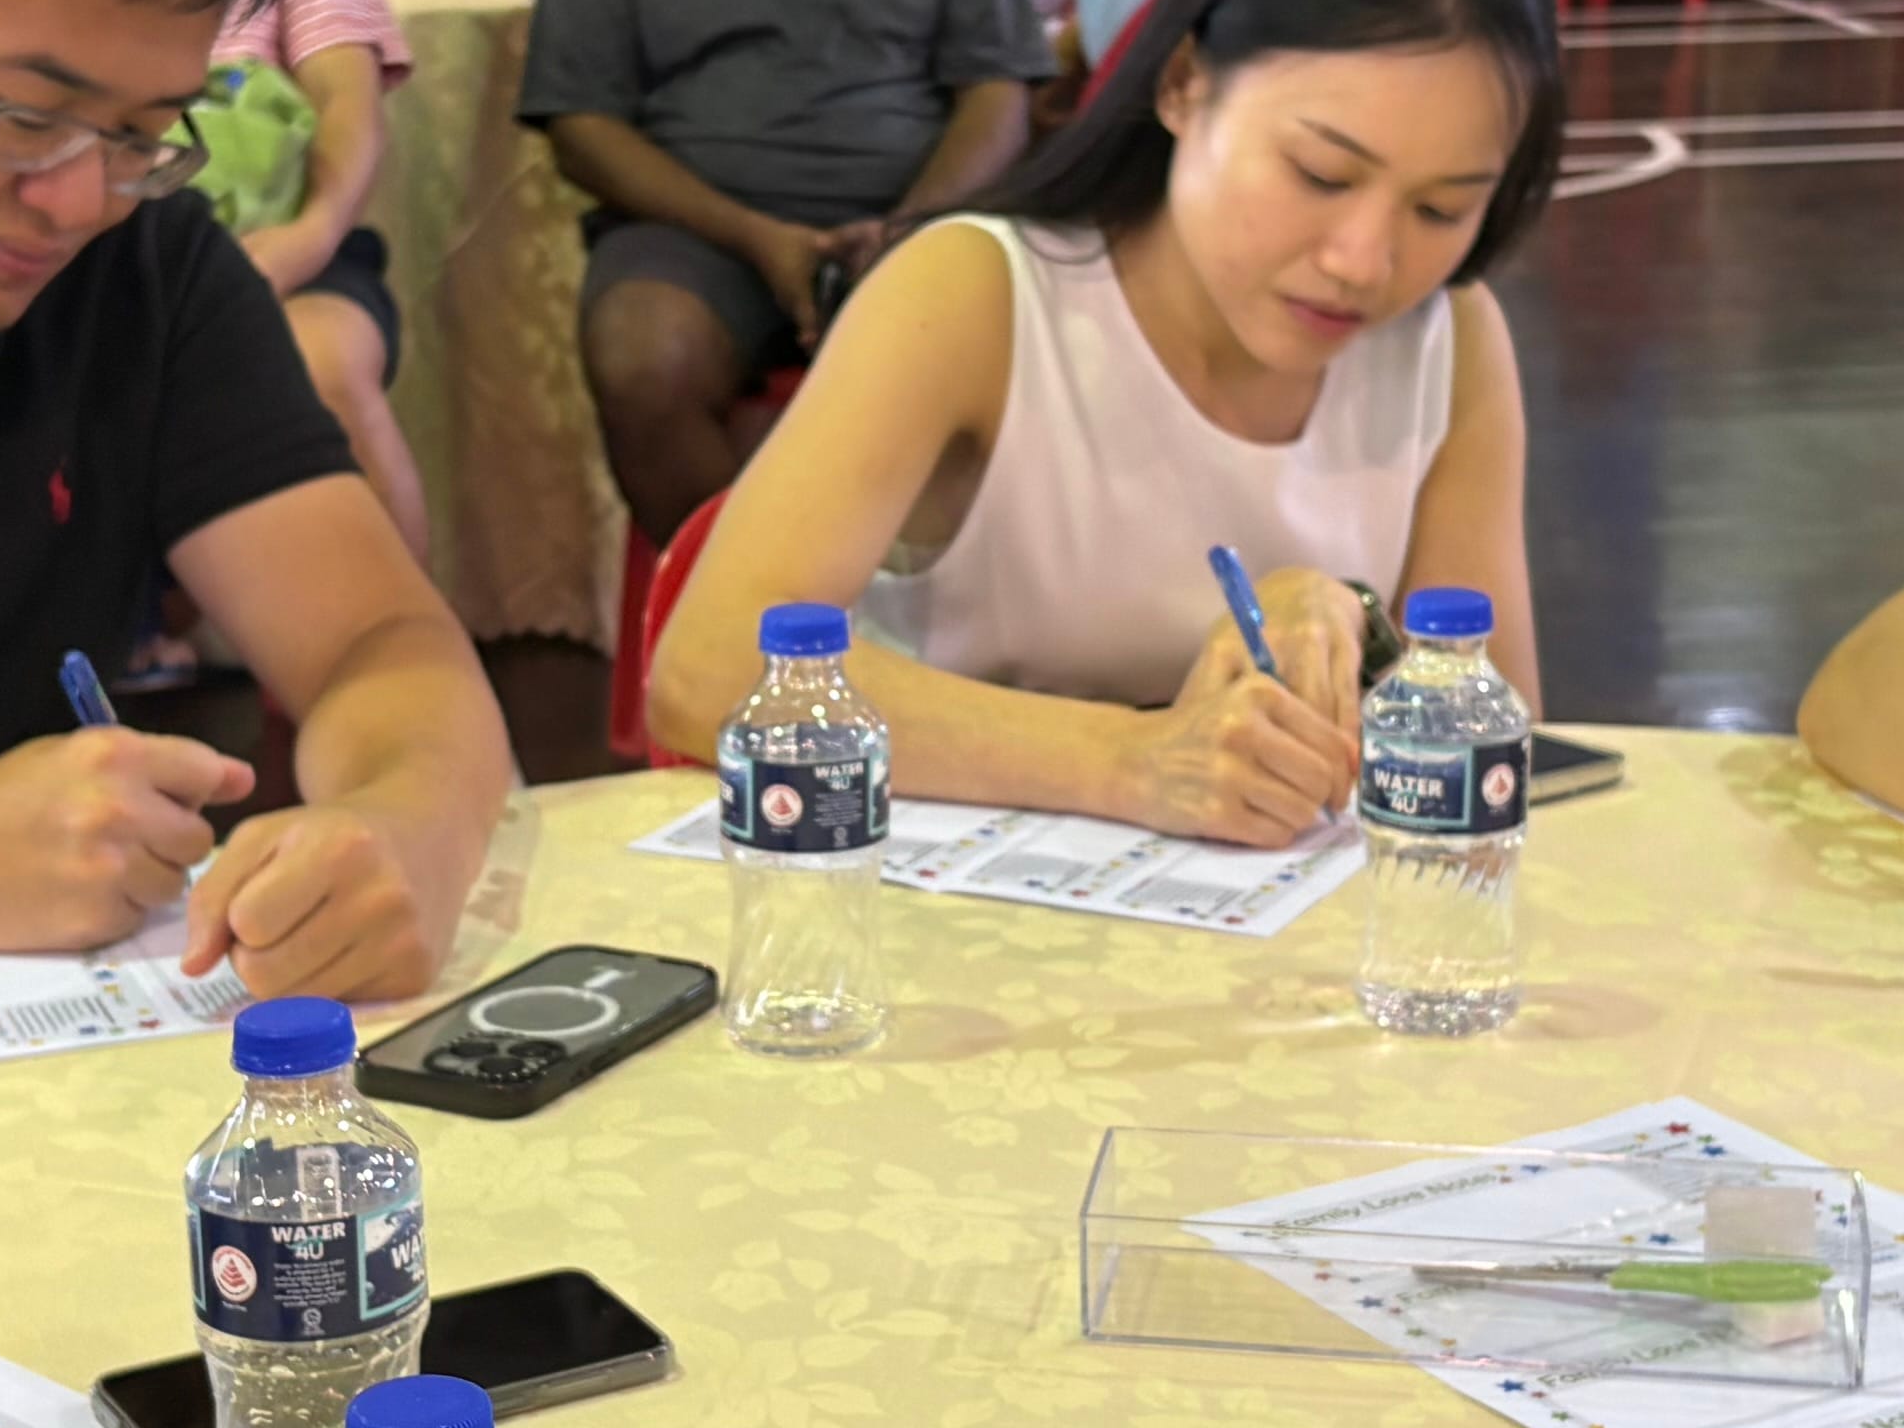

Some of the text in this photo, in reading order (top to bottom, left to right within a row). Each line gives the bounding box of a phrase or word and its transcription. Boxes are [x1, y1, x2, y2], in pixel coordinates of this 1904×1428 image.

[815, 762, 864, 780] WATER
[1374, 768, 1443, 798] WATER
[1390, 793, 1419, 815] 4U
[271, 1222, 346, 1243] WATER
[295, 1242, 325, 1261] 4U
